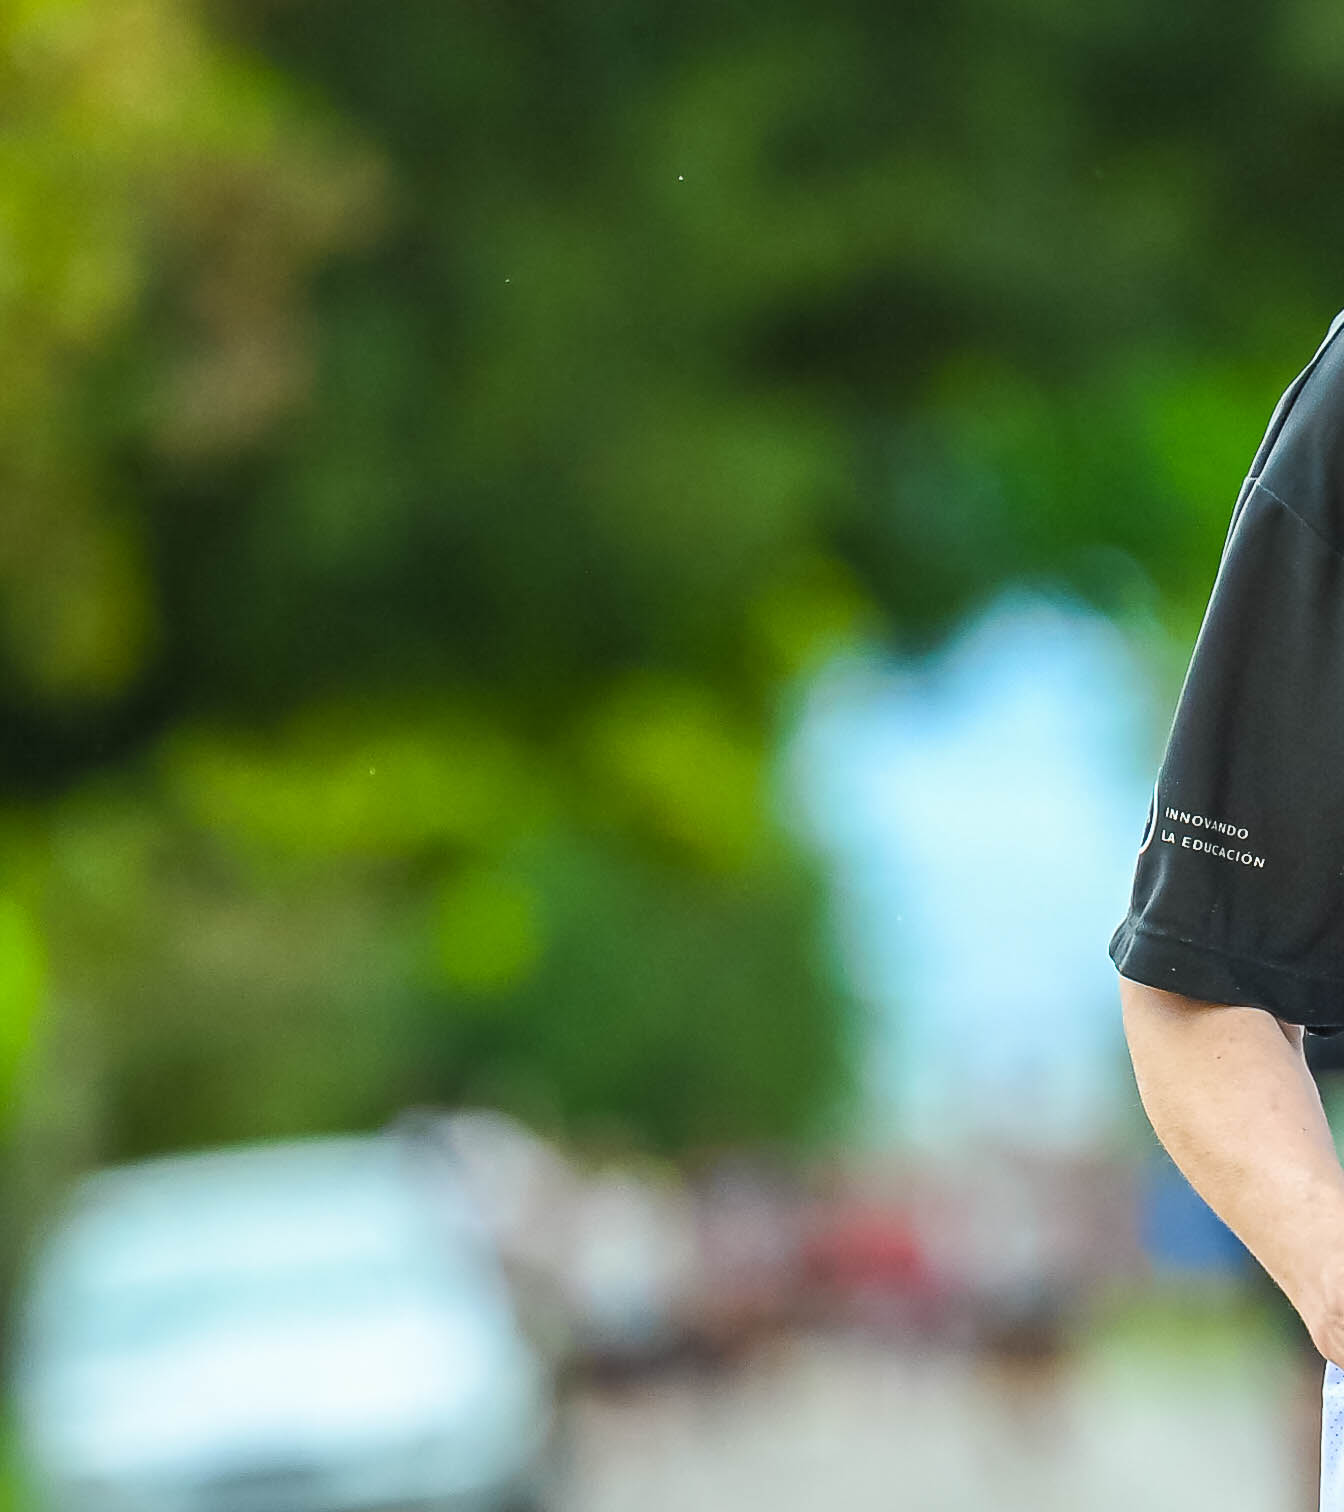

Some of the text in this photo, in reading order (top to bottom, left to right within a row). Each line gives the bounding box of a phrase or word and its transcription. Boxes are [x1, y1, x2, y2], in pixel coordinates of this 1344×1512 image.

[1164, 806, 1250, 840] INNOVANDO
[1160, 829, 1267, 869] LA EDUCACIÓN
